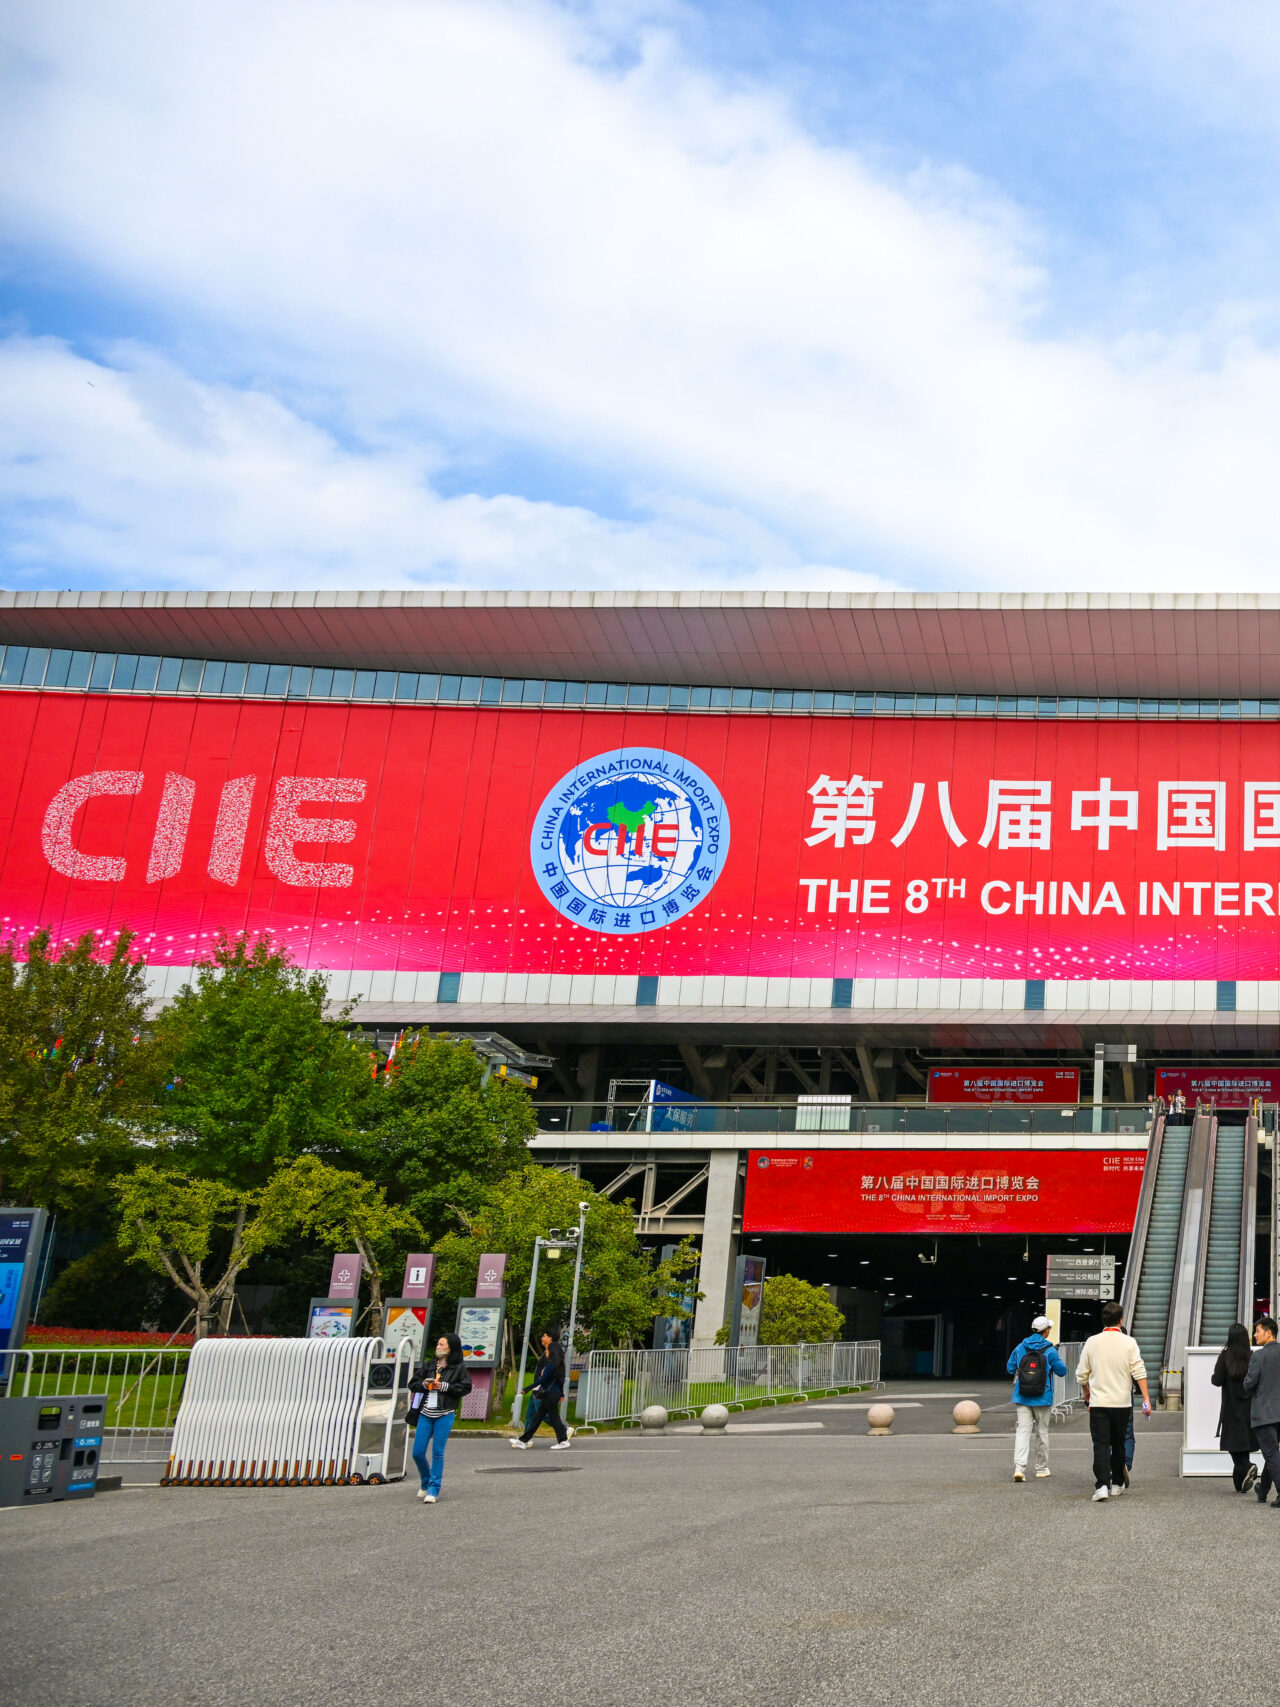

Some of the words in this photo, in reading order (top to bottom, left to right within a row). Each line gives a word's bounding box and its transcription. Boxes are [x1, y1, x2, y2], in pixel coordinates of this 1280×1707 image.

[41, 771, 367, 887] CIIE
[541, 805, 563, 850] CHINA
[560, 758, 670, 804] INTERNATIONAL
[672, 768, 715, 813] IMPORT
[707, 815, 720, 855] EXPO
[583, 822, 679, 857] CIIE
[542, 862, 713, 928] 中国国际进口博览会
[799, 879, 891, 913] THE
[905, 878, 966, 914] 8TH
[980, 880, 1126, 915] CHINA
[861, 1175, 1040, 1190] 第八届中国国际进口博览会
